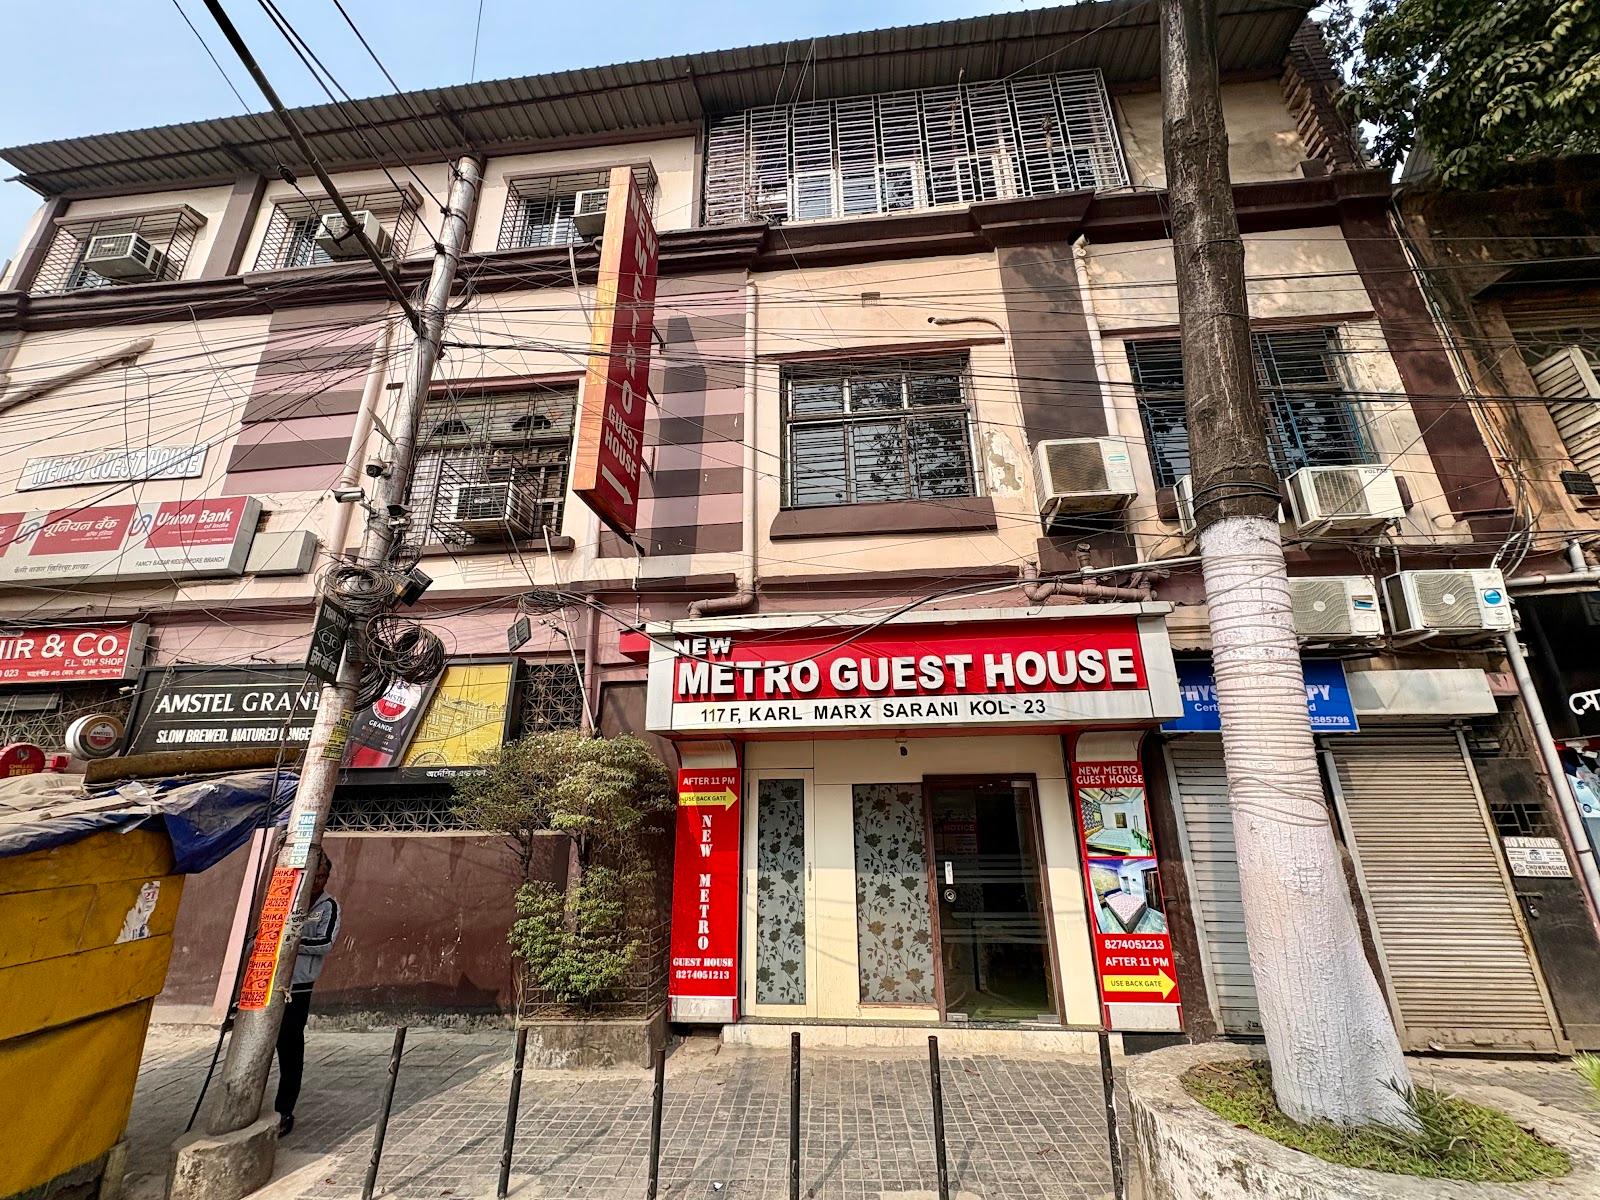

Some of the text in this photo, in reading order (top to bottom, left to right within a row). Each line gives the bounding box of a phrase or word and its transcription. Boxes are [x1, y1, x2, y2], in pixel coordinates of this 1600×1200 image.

[630, 187, 656, 259] NEW
[608, 404, 638, 456] GUEST
[605, 427, 637, 481] HOUSE
[32, 446, 199, 485] METRO GUEST HOUSE
[157, 508, 233, 526] Union Bank
[43, 516, 120, 538] यूनियन बैंक
[41, 633, 65, 658] &
[674, 637, 732, 657] NEW
[99, 658, 123, 666] SHOP
[678, 648, 1138, 695] METRO GUEST HOUSE
[155, 692, 235, 713] AMSTEL
[749, 706, 803, 721] KARL
[814, 704, 871, 719] MARX
[883, 701, 958, 717] SARANI
[1024, 700, 1046, 713] 23
[156, 729, 186, 743] SLOW
[185, 728, 229, 743] BREWED.
[231, 727, 280, 742] MATURED
[369, 719, 394, 733] GRANDE
[1078, 765, 1138, 775] NEW METRO
[683, 776, 735, 785] AFTER 11 PM
[1076, 774, 1144, 785] GUEST HOUSE
[700, 815, 712, 858] NEW
[1504, 837, 1560, 848] NO PARKING
[698, 873, 711, 950] METRO
[1105, 939, 1165, 950] 8274051213
[673, 957, 733, 967] GUEST HOUSE
[1105, 956, 1169, 967] AFTER 11 PM
[676, 970, 730, 979] 8274051213
[1144, 980, 1162, 988] GATE
